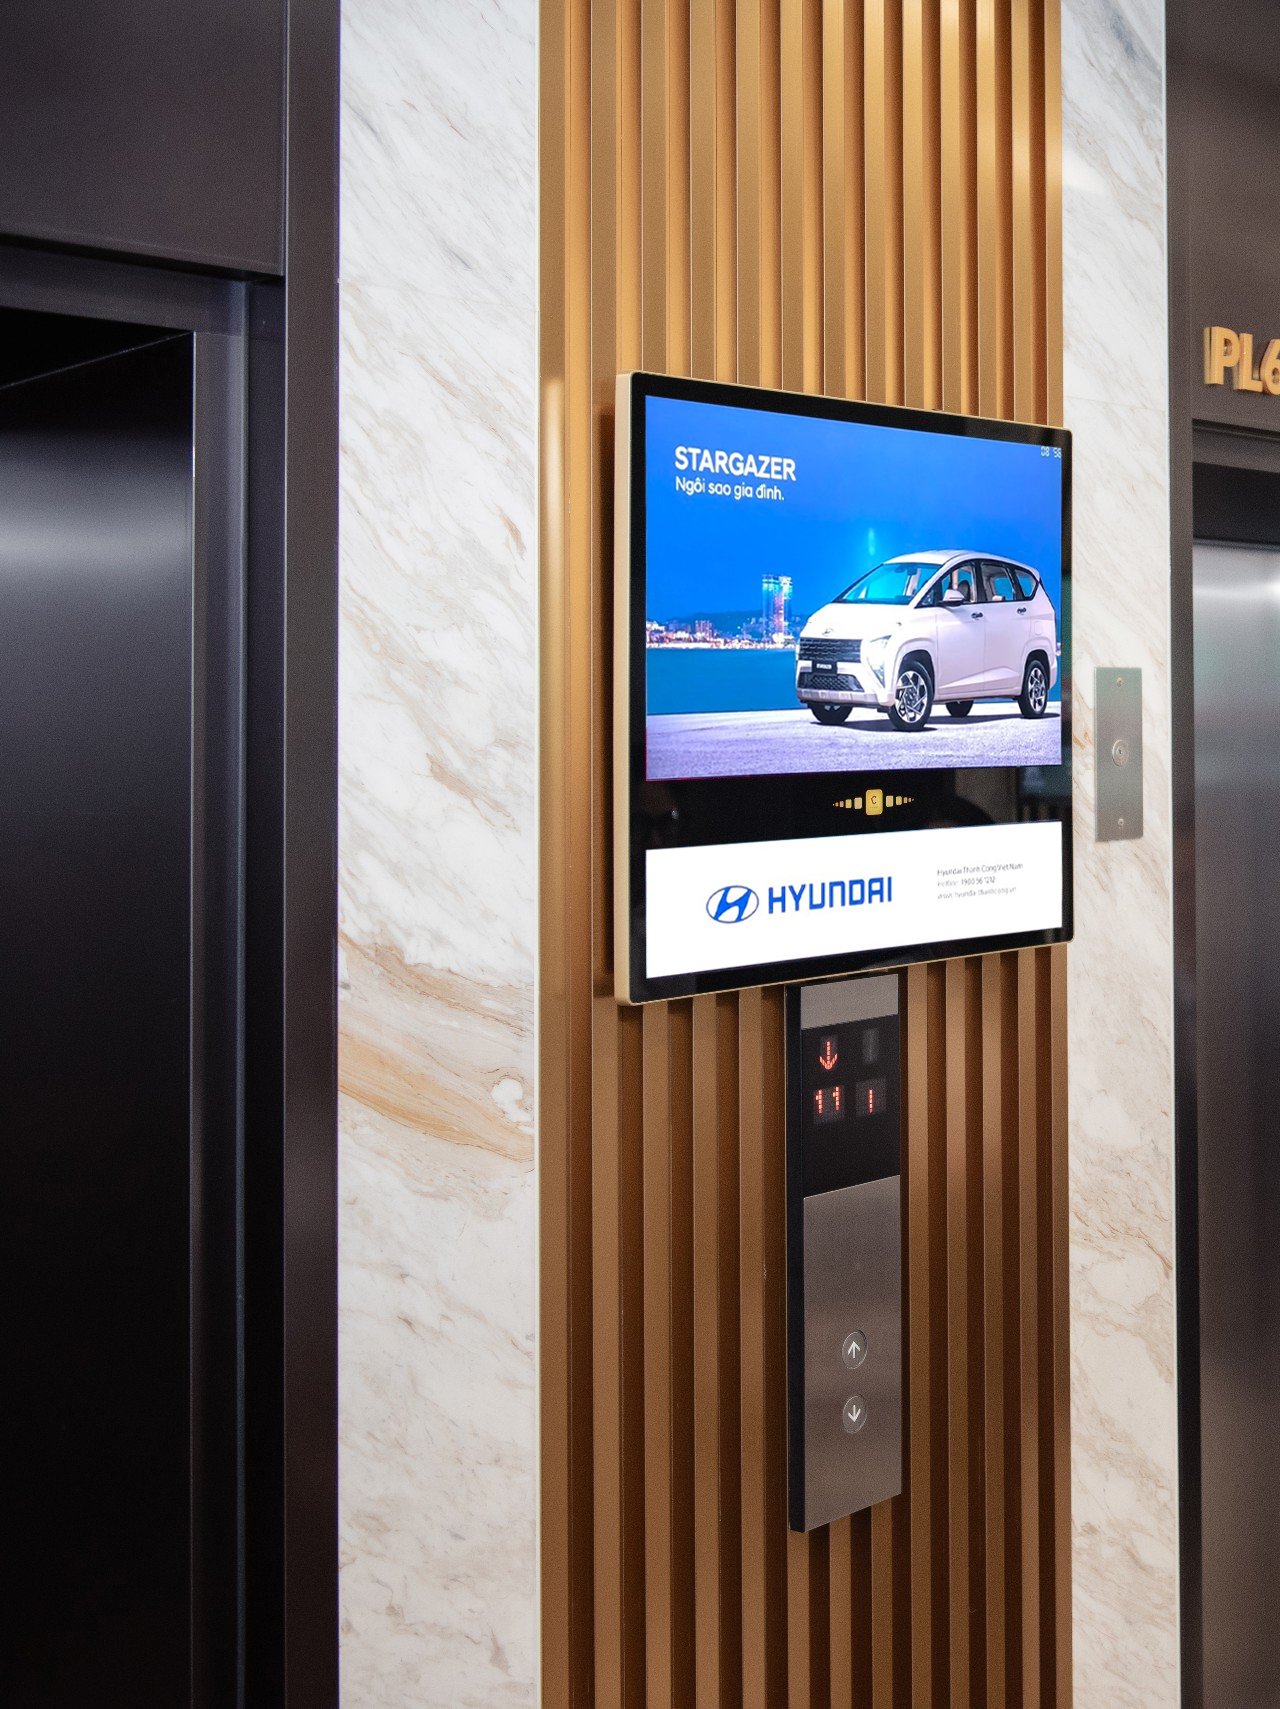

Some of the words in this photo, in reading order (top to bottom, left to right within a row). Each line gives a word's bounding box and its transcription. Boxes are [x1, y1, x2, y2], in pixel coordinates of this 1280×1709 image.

[675, 445, 797, 481] STARGAZER
[675, 476, 706, 496] Ngôi
[708, 481, 731, 496] sao
[734, 481, 753, 501] gia
[768, 876, 892, 914] HYUNDAI
